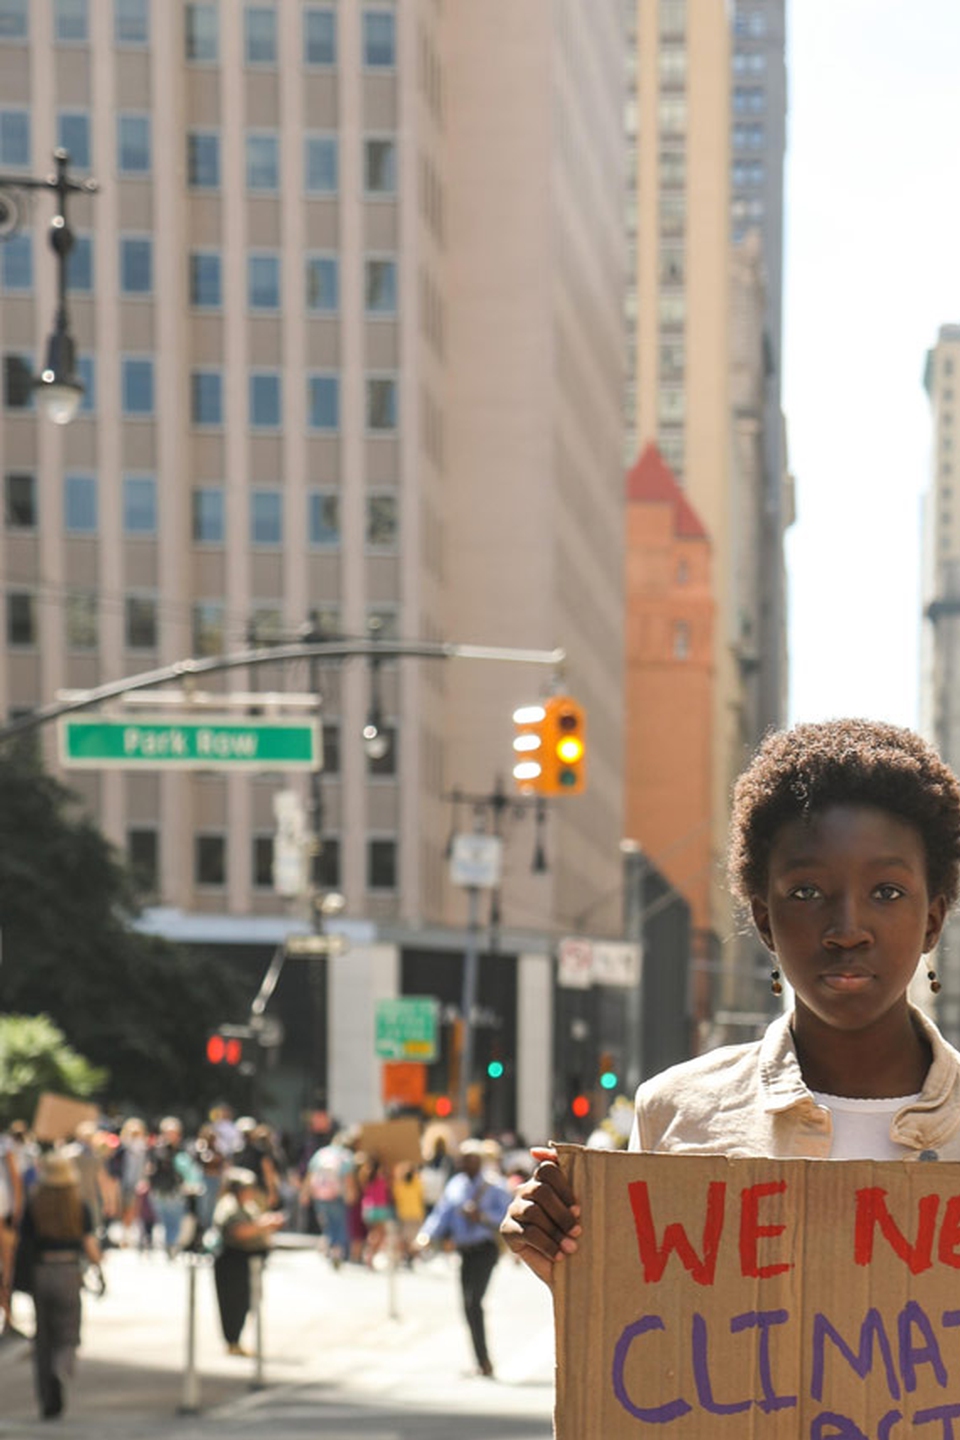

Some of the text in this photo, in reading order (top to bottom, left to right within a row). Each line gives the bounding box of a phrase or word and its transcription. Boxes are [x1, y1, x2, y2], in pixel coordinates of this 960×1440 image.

[123, 727, 259, 757] Park Row
[627, 1180, 796, 1286] WE
